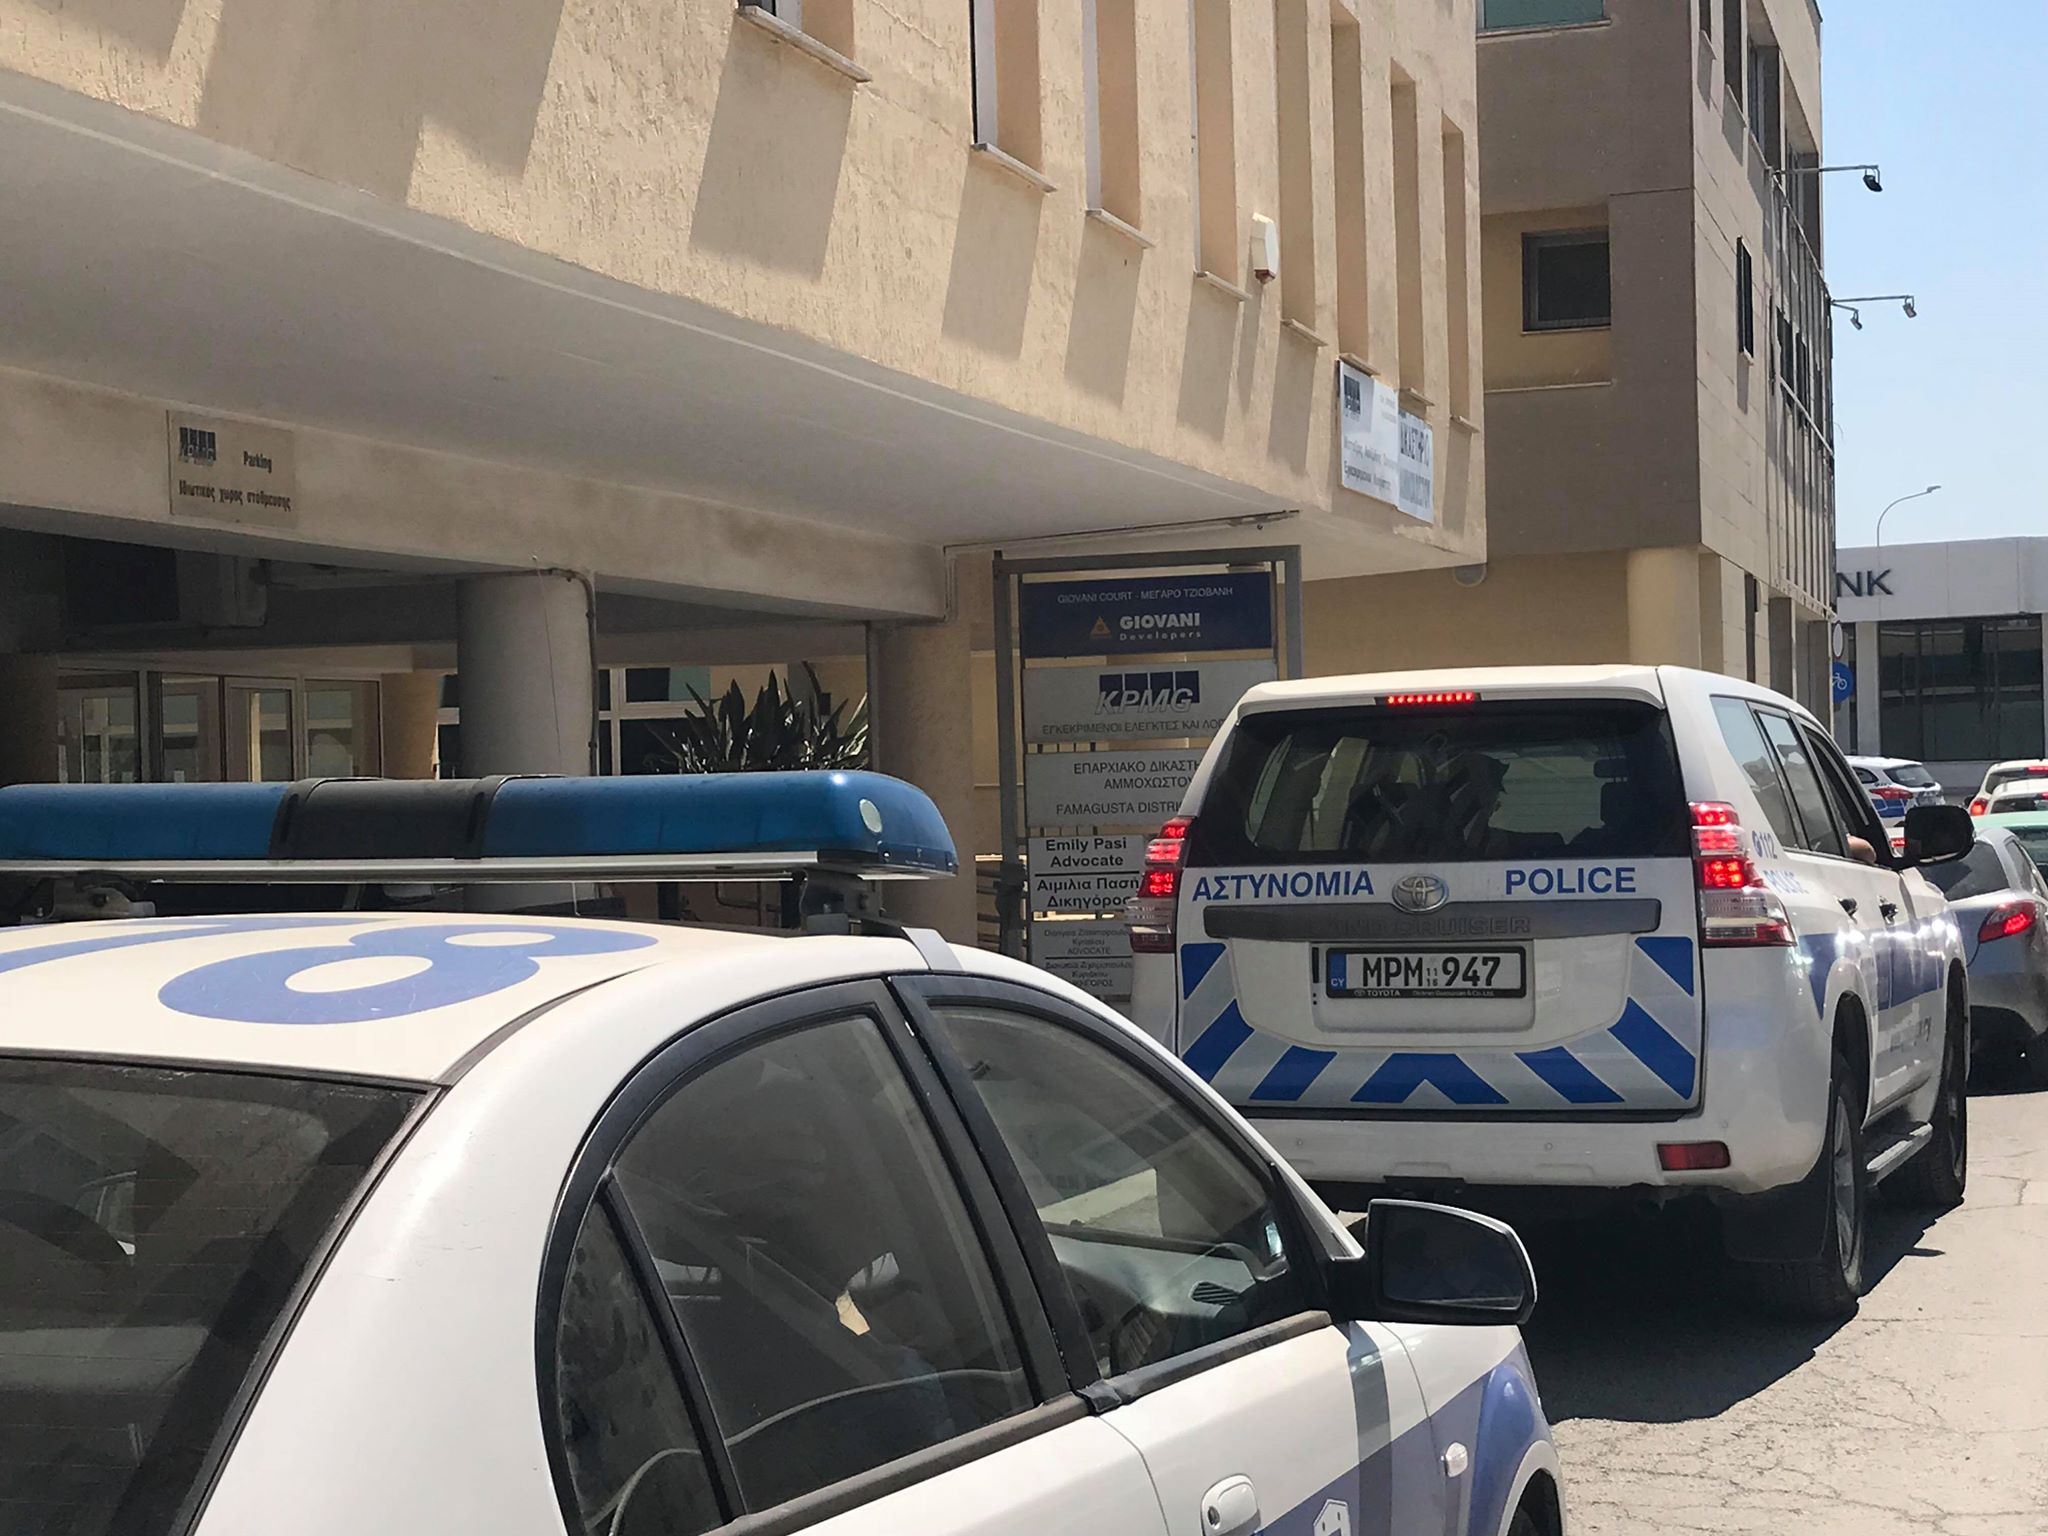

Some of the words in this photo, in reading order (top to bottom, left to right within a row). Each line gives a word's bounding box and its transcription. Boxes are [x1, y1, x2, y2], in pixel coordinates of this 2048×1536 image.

[243, 451, 272, 474] Parking
[1836, 569, 1893, 597] NK
[1099, 592, 1132, 602] COURT
[1119, 612, 1200, 630] GIOVANI
[1119, 631, 1202, 641] Developers
[1095, 688, 1194, 716] KPMG
[1125, 720, 1178, 733] ΕΛΕΓΚΤΕΣ
[1182, 719, 1200, 730] ΚΑΙ
[1073, 760, 1146, 774] ΕΠΑΡΧΙΑΚΟ
[1056, 802, 1134, 816] FAMAGUSTA
[1138, 801, 1182, 814] DISTRI
[1046, 839, 1089, 853] Emily
[1094, 837, 1127, 850] Pasi
[1050, 855, 1124, 868] Advocate
[1193, 871, 1374, 902] ΑΣΤΥΝΟΜΙΑ
[1505, 867, 1636, 895] POLICE
[1394, 916, 1531, 937] CRUISER
[1363, 957, 1423, 987] MPM
[1442, 956, 1501, 987] 947
[1331, 978, 1345, 987] CY
[1367, 989, 1400, 997] TOYOTA
